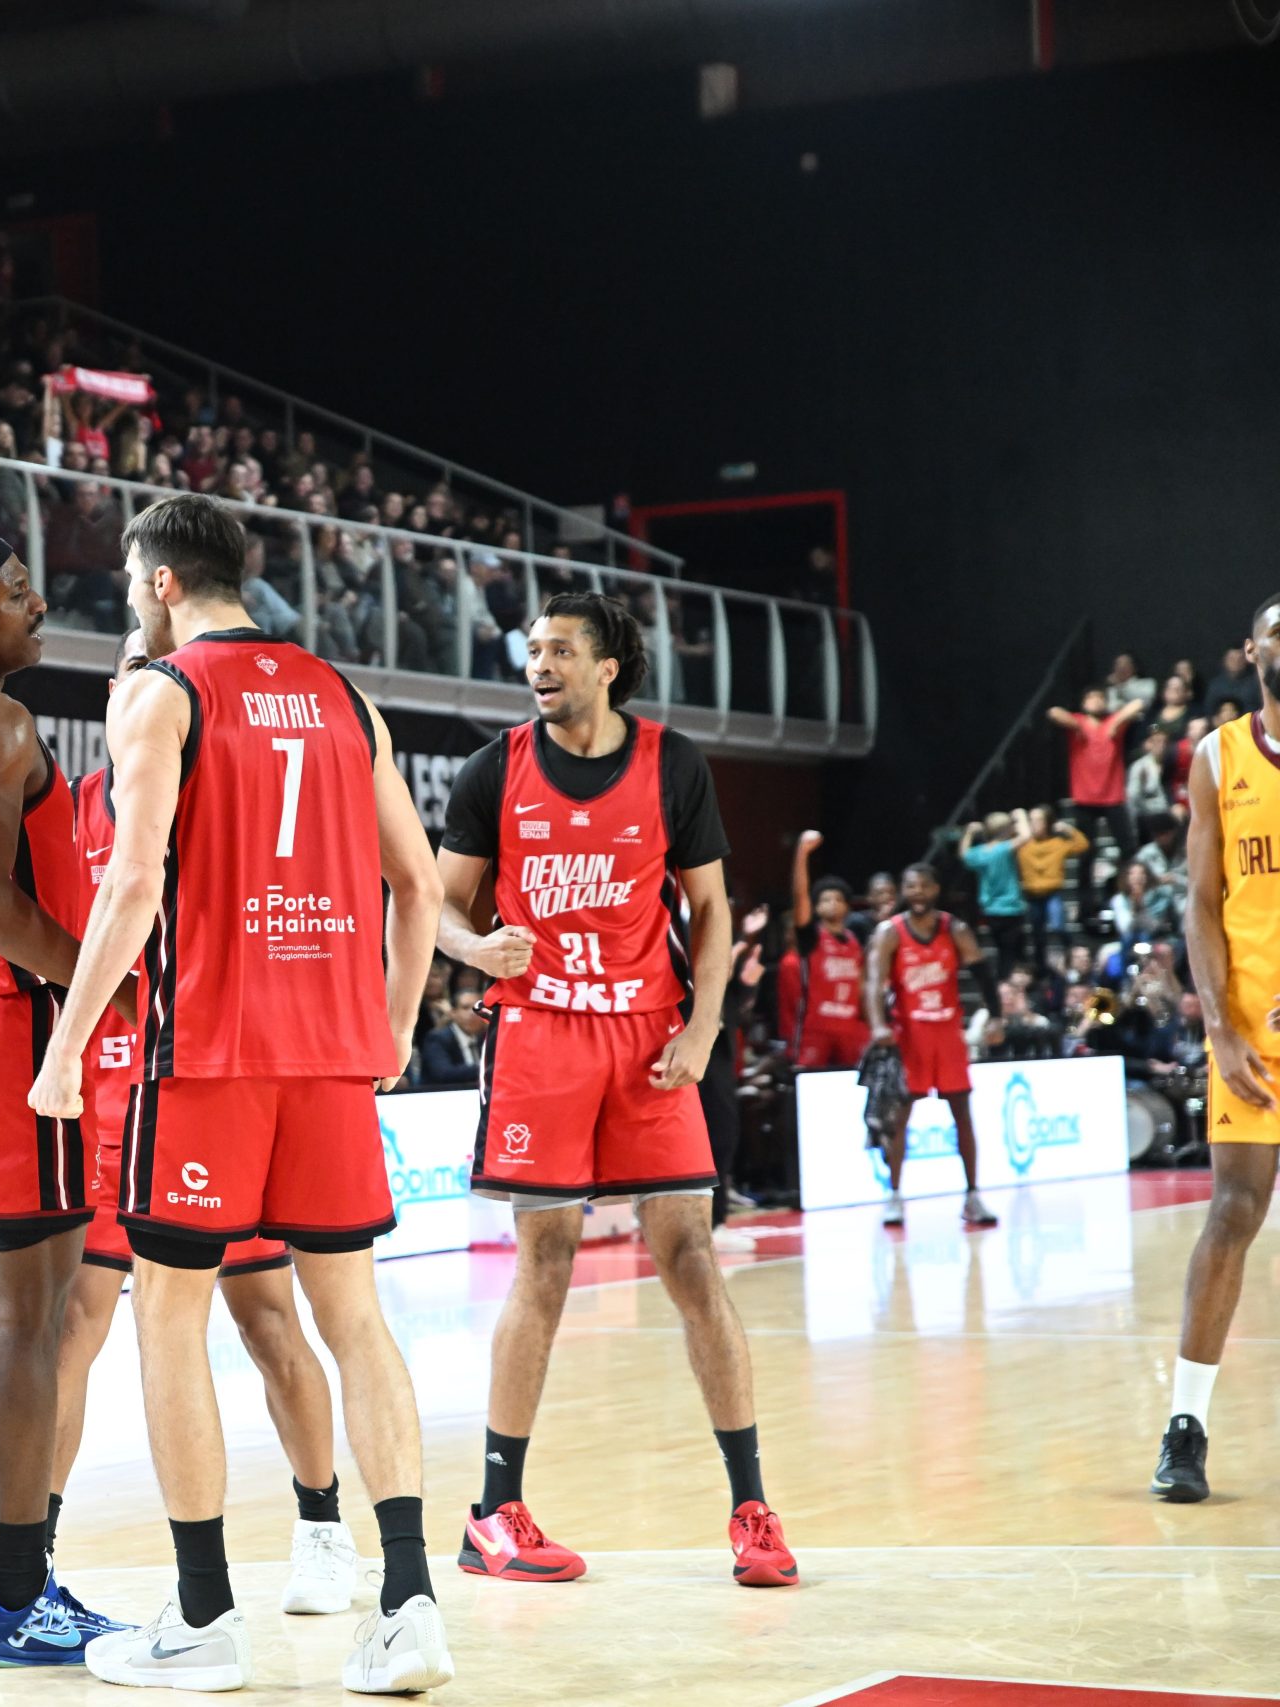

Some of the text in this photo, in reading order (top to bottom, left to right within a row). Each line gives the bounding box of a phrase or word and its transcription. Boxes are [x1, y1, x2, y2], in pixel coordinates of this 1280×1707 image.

[242, 692, 324, 729] CORTALE
[272, 738, 304, 857] 7
[521, 854, 615, 892] DENAIN
[1238, 835, 1280, 876] ORL
[267, 893, 331, 912] Porte
[530, 869, 637, 919] VOLTAIRE
[267, 915, 356, 934] Hainaut
[559, 933, 605, 975] 21
[530, 974, 643, 1013] SKF
